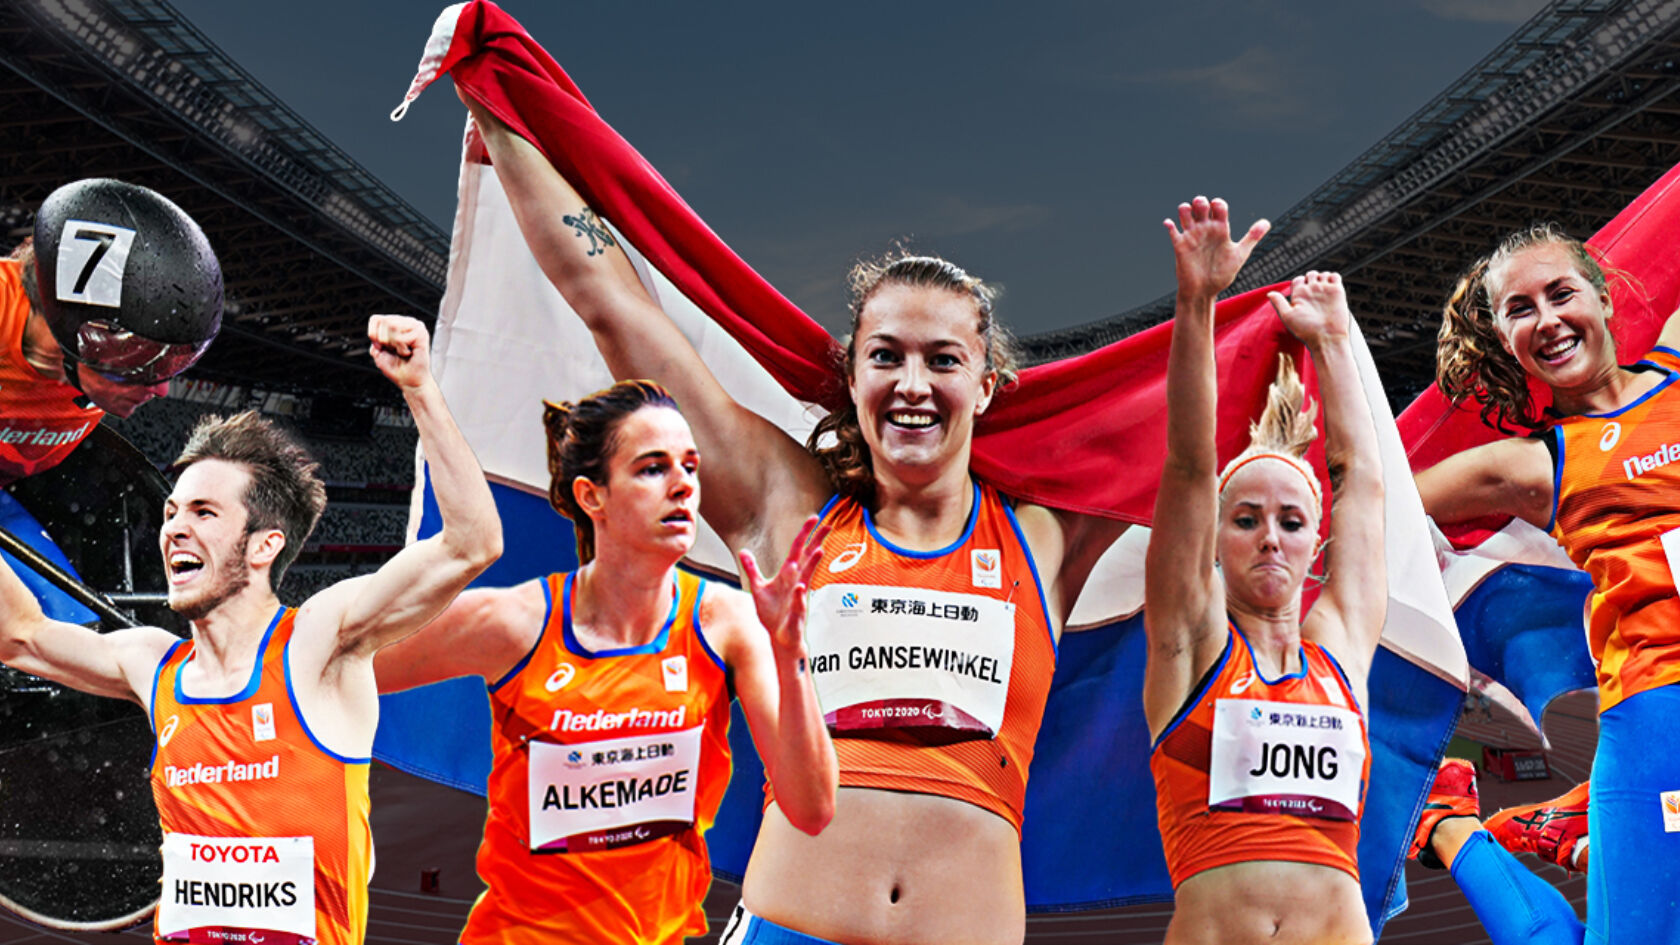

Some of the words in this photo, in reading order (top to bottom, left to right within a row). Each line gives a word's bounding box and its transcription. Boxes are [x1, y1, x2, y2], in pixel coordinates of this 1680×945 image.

[73, 230, 116, 294] 7
[871, 598, 979, 622] 東京海上日動
[809, 653, 840, 674] van
[849, 646, 1002, 684] GANSEWINKEL
[861, 707, 893, 718] TOKYO
[895, 706, 920, 717] 2020
[1250, 742, 1338, 780] JONG
[542, 769, 689, 811] ALKEMADE
[190, 843, 280, 863] TOYOTA
[175, 879, 297, 908] HENDRIKS
